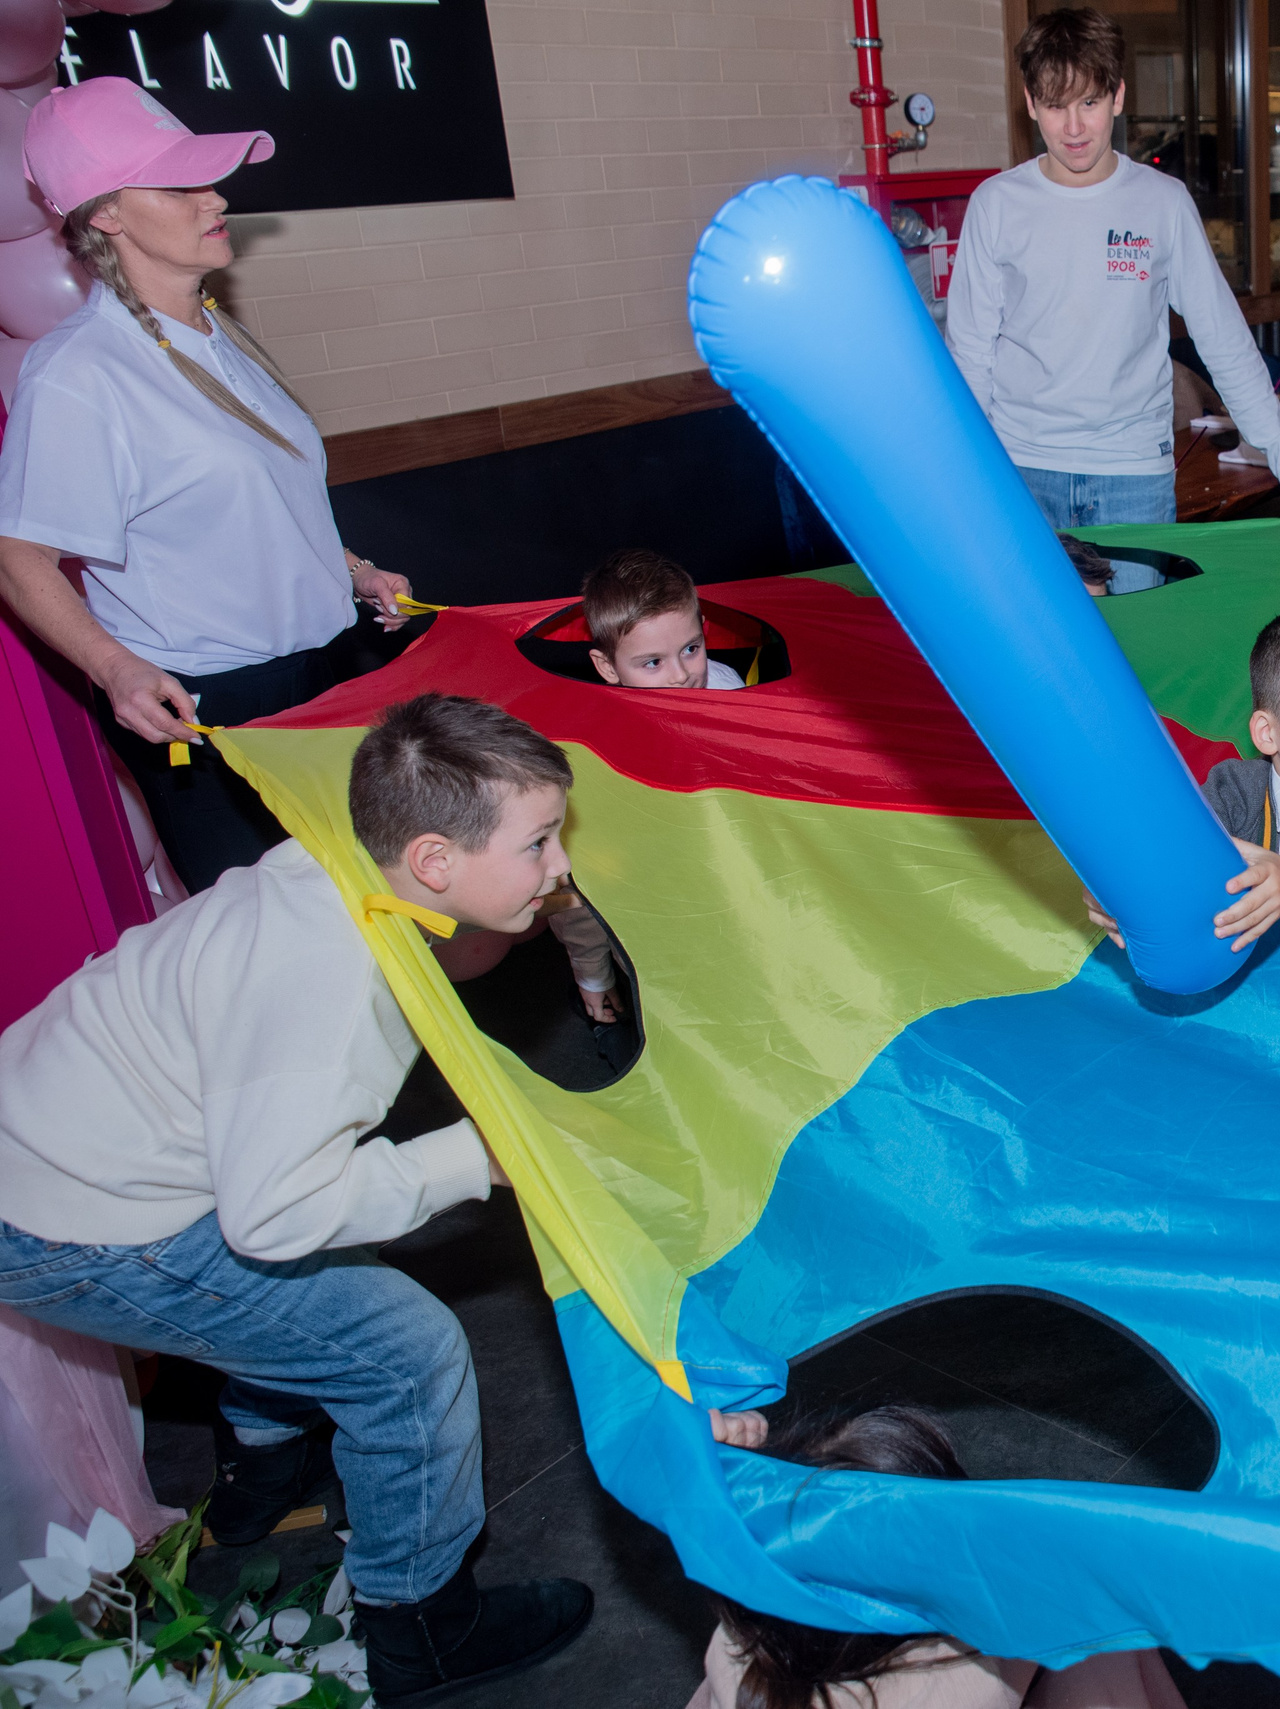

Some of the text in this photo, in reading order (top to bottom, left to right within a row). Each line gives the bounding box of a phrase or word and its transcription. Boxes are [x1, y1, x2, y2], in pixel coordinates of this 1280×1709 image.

[60, 26, 417, 91] FLAVOR
[1107, 229, 1154, 251] Lee Cooper
[1107, 247, 1150, 260] DENIM
[1107, 260, 1136, 272] 1908
